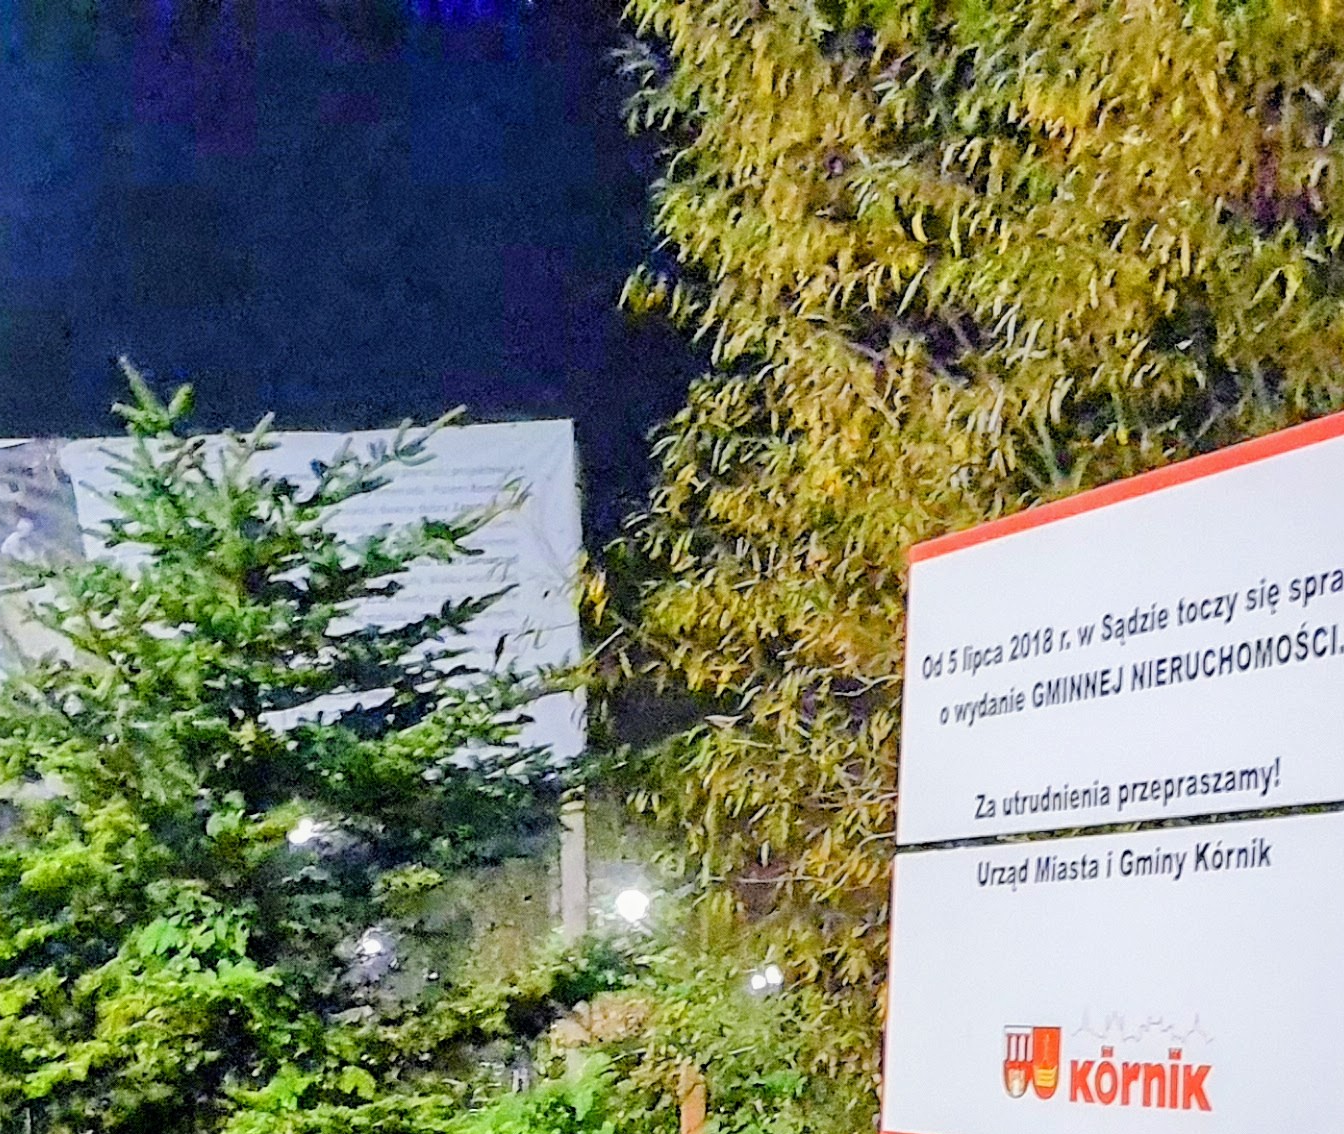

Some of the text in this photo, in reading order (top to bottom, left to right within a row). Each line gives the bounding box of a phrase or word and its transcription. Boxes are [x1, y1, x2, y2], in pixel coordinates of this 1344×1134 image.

[922, 651, 943, 680] Od
[947, 648, 958, 675] 5
[962, 644, 1003, 677] lipca
[1008, 627, 1054, 661] 2018
[1058, 629, 1071, 651] r.
[1077, 623, 1096, 646] w
[1101, 602, 1168, 646] Sądzie
[1177, 592, 1238, 624] toczy
[1245, 578, 1280, 615] się
[939, 706, 949, 725] o
[954, 687, 1026, 727] wydanie
[1031, 664, 1124, 709] GMINNEJ
[974, 756, 1281, 820] Za utrudnienia przepraszamy!
[977, 837, 1272, 892] Urząd Miasta i Gminy Kórnik
